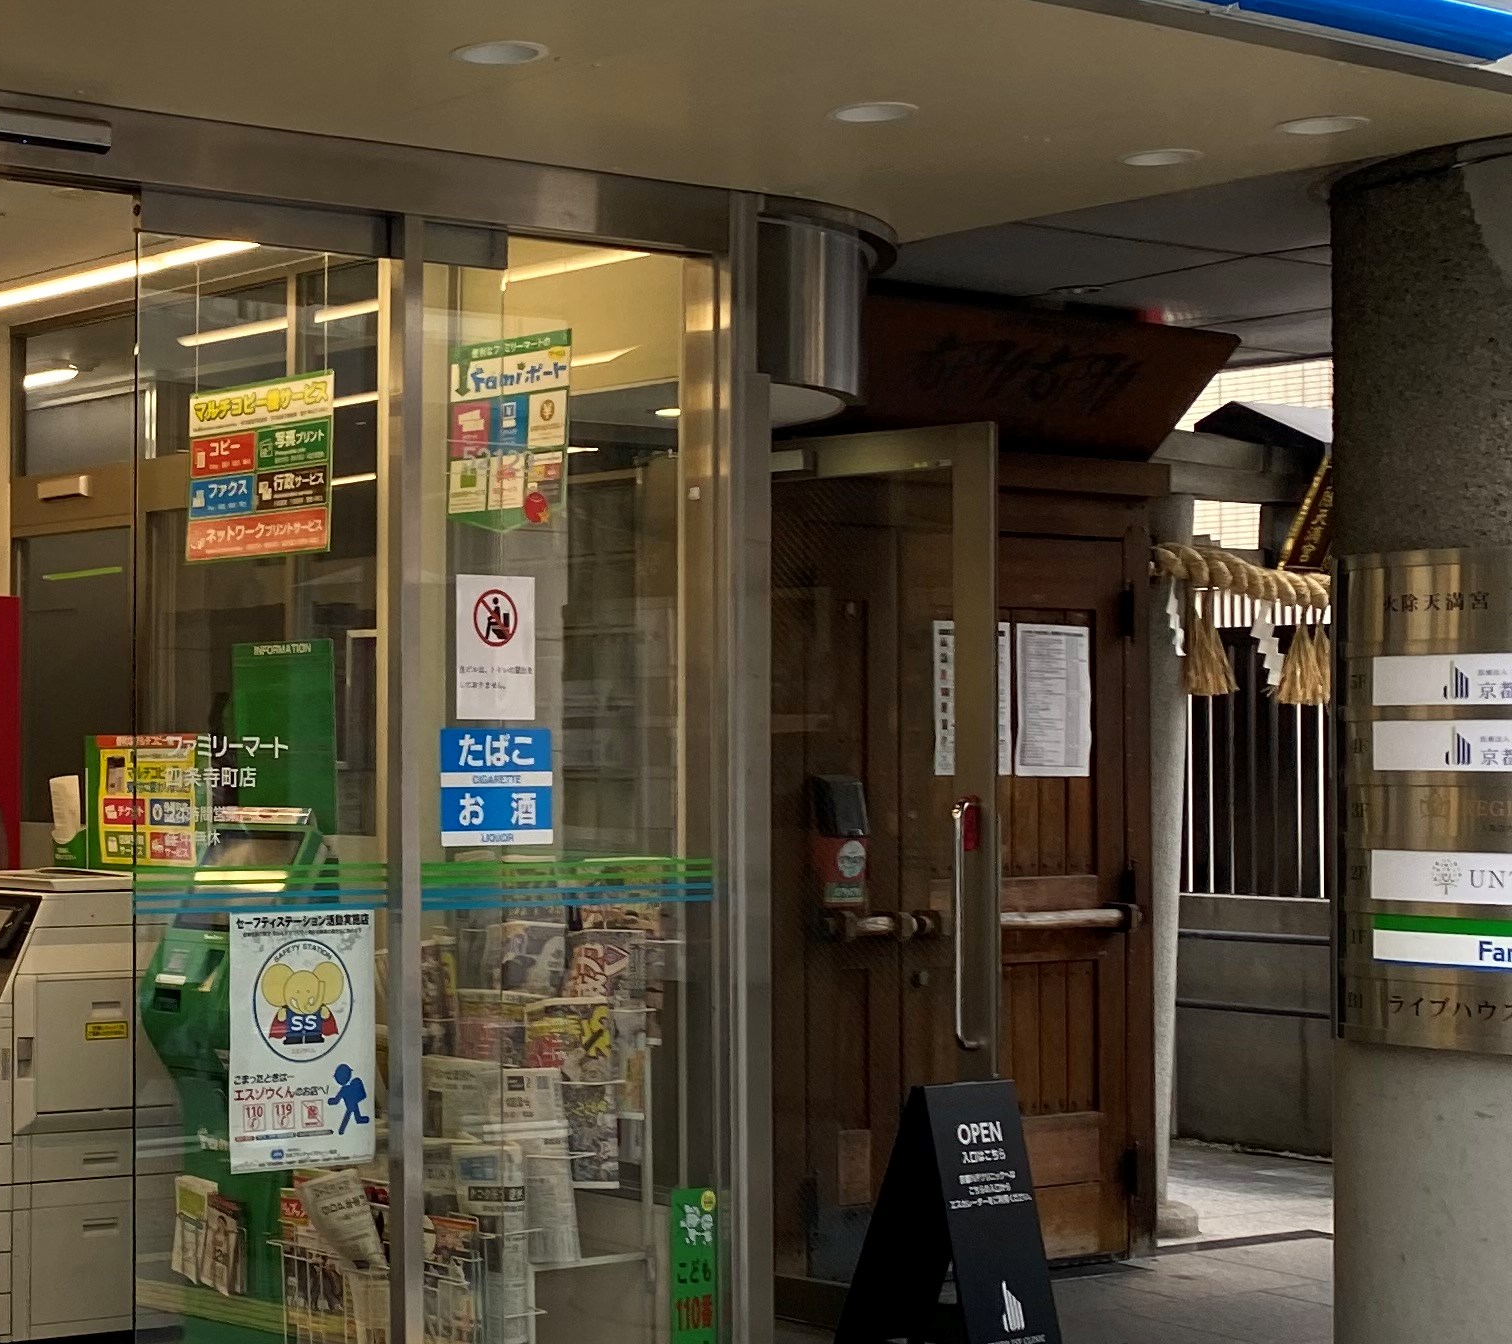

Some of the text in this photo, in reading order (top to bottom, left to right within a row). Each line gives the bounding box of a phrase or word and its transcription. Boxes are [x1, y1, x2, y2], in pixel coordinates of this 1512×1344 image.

[209, 440, 241, 457] コピー
[253, 643, 312, 656] INFORMATION
[458, 733, 535, 767] たばこ
[472, 775, 522, 785] CIGARETTE
[459, 792, 537, 826] お酒
[480, 833, 515, 844] LIQUOR
[1469, 869, 1512, 889] UN
[291, 1014, 318, 1032] SS
[956, 1120, 1004, 1146] OPEN
